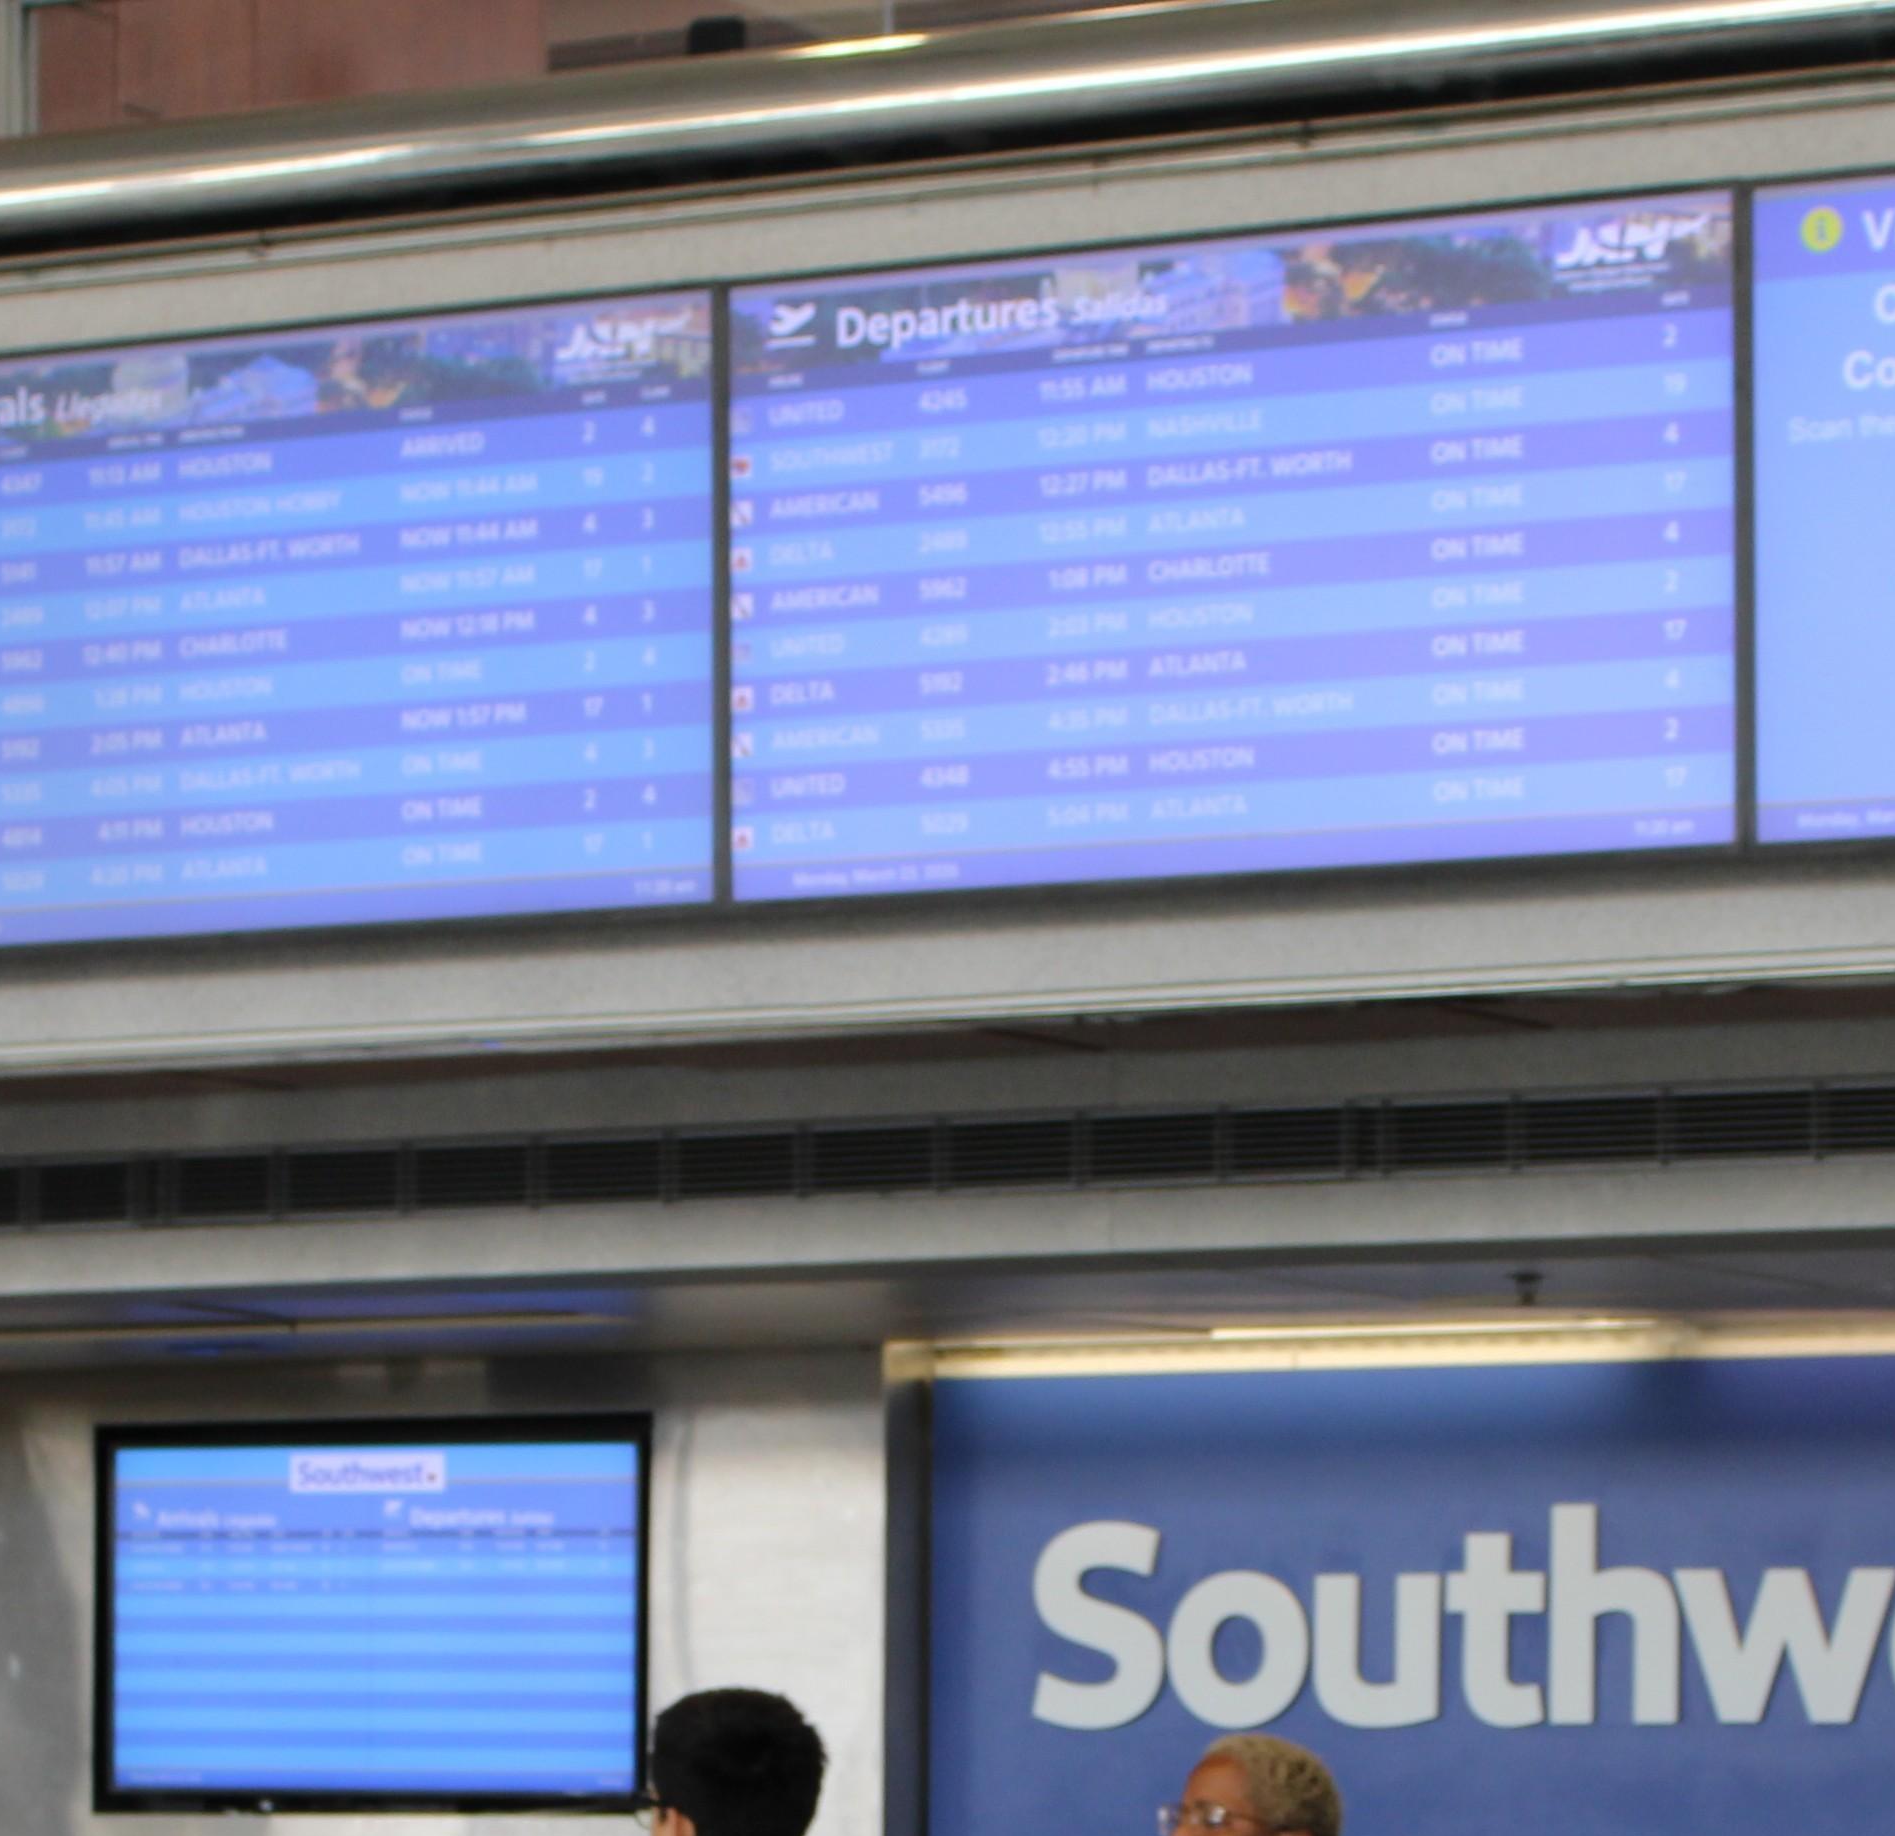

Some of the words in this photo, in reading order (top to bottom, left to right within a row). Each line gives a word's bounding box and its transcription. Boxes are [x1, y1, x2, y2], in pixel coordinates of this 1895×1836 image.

[836, 286, 1060, 355] Departures
[1073, 285, 1169, 325] Salidas
[768, 397, 844, 425] UNITED
[1090, 372, 1127, 397] AM
[1146, 361, 1253, 392] HOUSTON
[1428, 341, 1466, 367] ON
[1470, 336, 1523, 363] TIME
[1428, 390, 1466, 416] ON
[1470, 385, 1523, 412] TIME
[1789, 411, 1853, 444] Scan
[129, 460, 162, 484] AM
[178, 451, 273, 480] HOUSTON
[400, 432, 486, 460] ARRIVED
[769, 488, 879, 518] AMERICAN
[1091, 467, 1127, 492] PM
[1269, 448, 1353, 477] WORTH
[1429, 439, 1466, 464] ON
[1470, 434, 1523, 461] TIME
[1147, 505, 1246, 535] ATLANTA
[1429, 487, 1466, 513] ON
[1471, 483, 1523, 509] TIME
[129, 550, 162, 573] AM
[287, 533, 361, 560] WORTH
[400, 526, 450, 551] NOW
[504, 518, 538, 542] AM
[770, 581, 880, 611] AMERICAN
[1093, 562, 1128, 587] PM
[1148, 551, 1271, 582] CHARLOTTE
[1429, 536, 1467, 561] ON
[1471, 532, 1524, 558] TIME
[1429, 585, 1467, 610] ON
[1471, 581, 1524, 607] TIME
[131, 639, 162, 662] PM
[180, 629, 288, 658] CHARLOTTE
[400, 616, 450, 641] NOW
[503, 610, 536, 633] PM
[769, 678, 835, 704] DELTA
[1093, 657, 1128, 681] PM
[1147, 649, 1246, 678] ATLANTA
[1429, 633, 1467, 658] ON
[1471, 629, 1524, 655] TIME
[131, 728, 162, 751] PM
[180, 720, 267, 747] ATLANTA
[400, 707, 451, 732] NOW
[494, 701, 527, 725] PM
[770, 771, 845, 797] UNITED
[1094, 752, 1129, 776] PM
[1148, 744, 1255, 773] HOUSTON
[1430, 731, 1467, 755] ON
[1471, 727, 1524, 753] TIME
[132, 817, 164, 840] PM
[179, 810, 274, 837] HOUSTON
[400, 799, 433, 822] ON
[437, 795, 482, 819] TIME
[297, 1461, 424, 1486] Southwest
